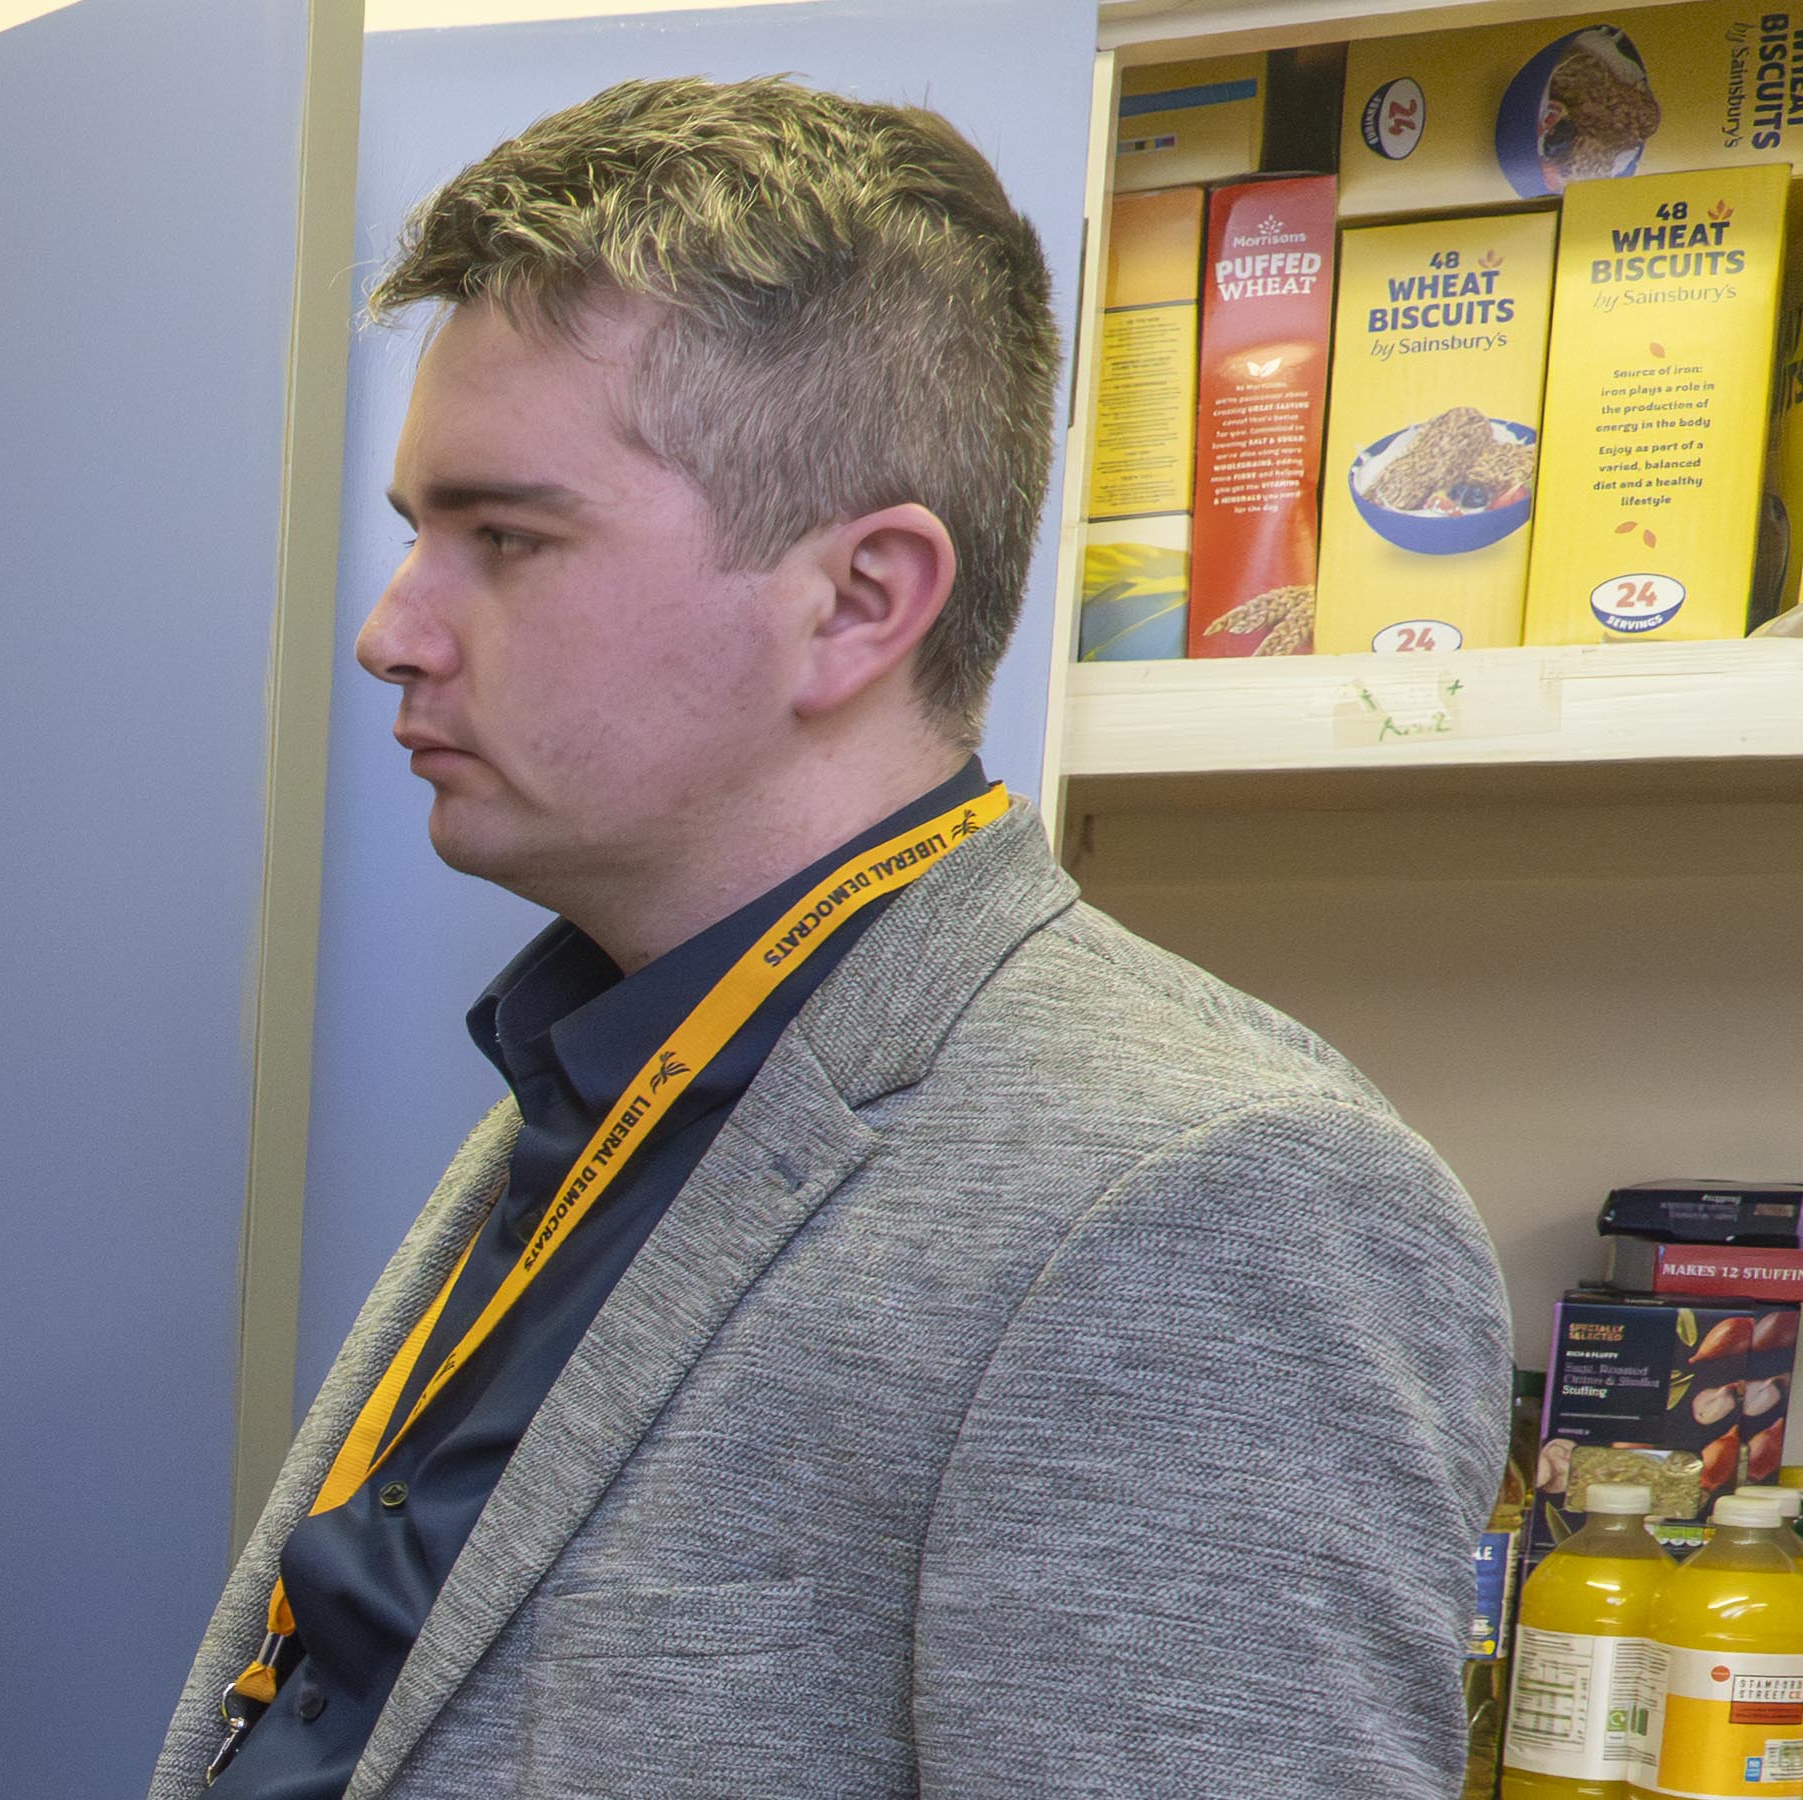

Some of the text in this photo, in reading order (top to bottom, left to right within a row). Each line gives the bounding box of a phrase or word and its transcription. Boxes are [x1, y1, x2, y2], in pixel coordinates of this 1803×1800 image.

[1751, 13, 1789, 150] BISCUITS
[1722, 46, 1750, 149] Sainsbury's
[1388, 99, 1417, 135] 24
[1656, 201, 1688, 221] 48
[1233, 232, 1307, 247] Morrisons
[1612, 221, 1731, 254] WHEAT
[1215, 252, 1321, 283] PUFFED
[1429, 251, 1460, 269] 48
[1590, 250, 1745, 284] BISCUITS
[1217, 276, 1317, 301] WHEAT
[1388, 270, 1500, 303] WHEAT
[1593, 284, 1737, 313] by Sainsbury's
[1368, 298, 1515, 333] BISCUITS
[1370, 332, 1507, 362] by Sainsbury's
[1613, 368, 1656, 379] Source
[1658, 365, 1671, 375] of
[1601, 387, 1627, 397] iron
[1629, 385, 1663, 397] plays
[1675, 382, 1700, 392] role
[1703, 381, 1715, 391] in
[1602, 399, 1709, 415] the production of
[1596, 417, 1711, 432] energy in the body
[1598, 445, 1632, 456] Enjoy
[1635, 445, 1649, 453] as
[1651, 441, 1678, 453] part
[1681, 440, 1694, 450] of
[1644, 457, 1701, 470] balanced
[1593, 480, 1617, 490] diet
[1620, 479, 1642, 489] and
[1655, 476, 1703, 487] healthy
[1621, 495, 1672, 507] lifestyle
[1616, 580, 1657, 608] 24
[1606, 614, 1663, 631] SERVINGS
[1396, 627, 1436, 652] 24
[763, 833, 948, 968] LIBERAL DEMOCRATS
[523, 1094, 652, 1273] LIBERAL DEMOCRATS
[1662, 1264, 1716, 1278] MAKES
[1722, 1265, 1739, 1278] 12
[1562, 1385, 1608, 1399] Stuffing
